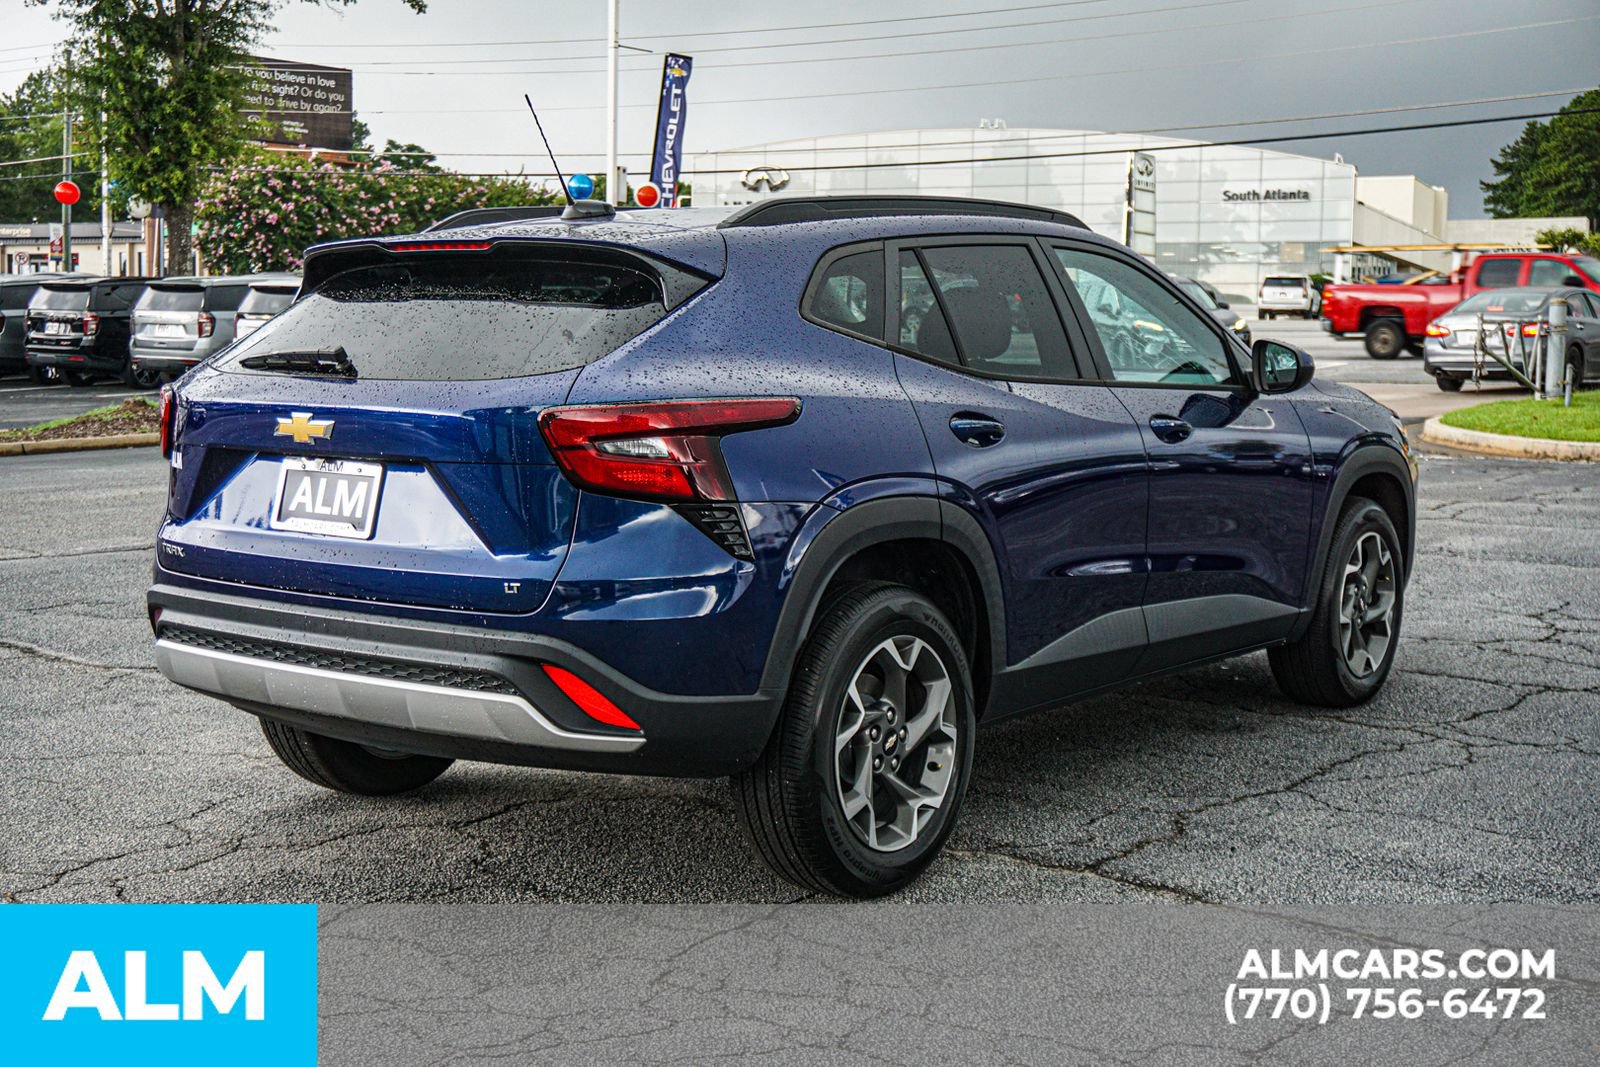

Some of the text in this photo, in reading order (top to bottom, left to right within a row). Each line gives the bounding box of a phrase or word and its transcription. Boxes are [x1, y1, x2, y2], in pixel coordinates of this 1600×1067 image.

[255, 69, 272, 80] you
[274, 70, 306, 84] believe
[307, 75, 316, 85] in
[317, 76, 336, 88] love
[272, 83, 299, 97] sight?
[301, 87, 313, 97] Or
[314, 89, 327, 99] do
[328, 92, 345, 102] you
[264, 97, 275, 106] to
[277, 98, 299, 109] drive
[300, 100, 311, 112] by
[313, 103, 342, 114] again?
[1223, 189, 1310, 201] South Atlanta
[320, 460, 344, 472] ALM
[288, 476, 368, 518] ALM
[162, 543, 184, 558] TRAX
[504, 583, 520, 593] LT
